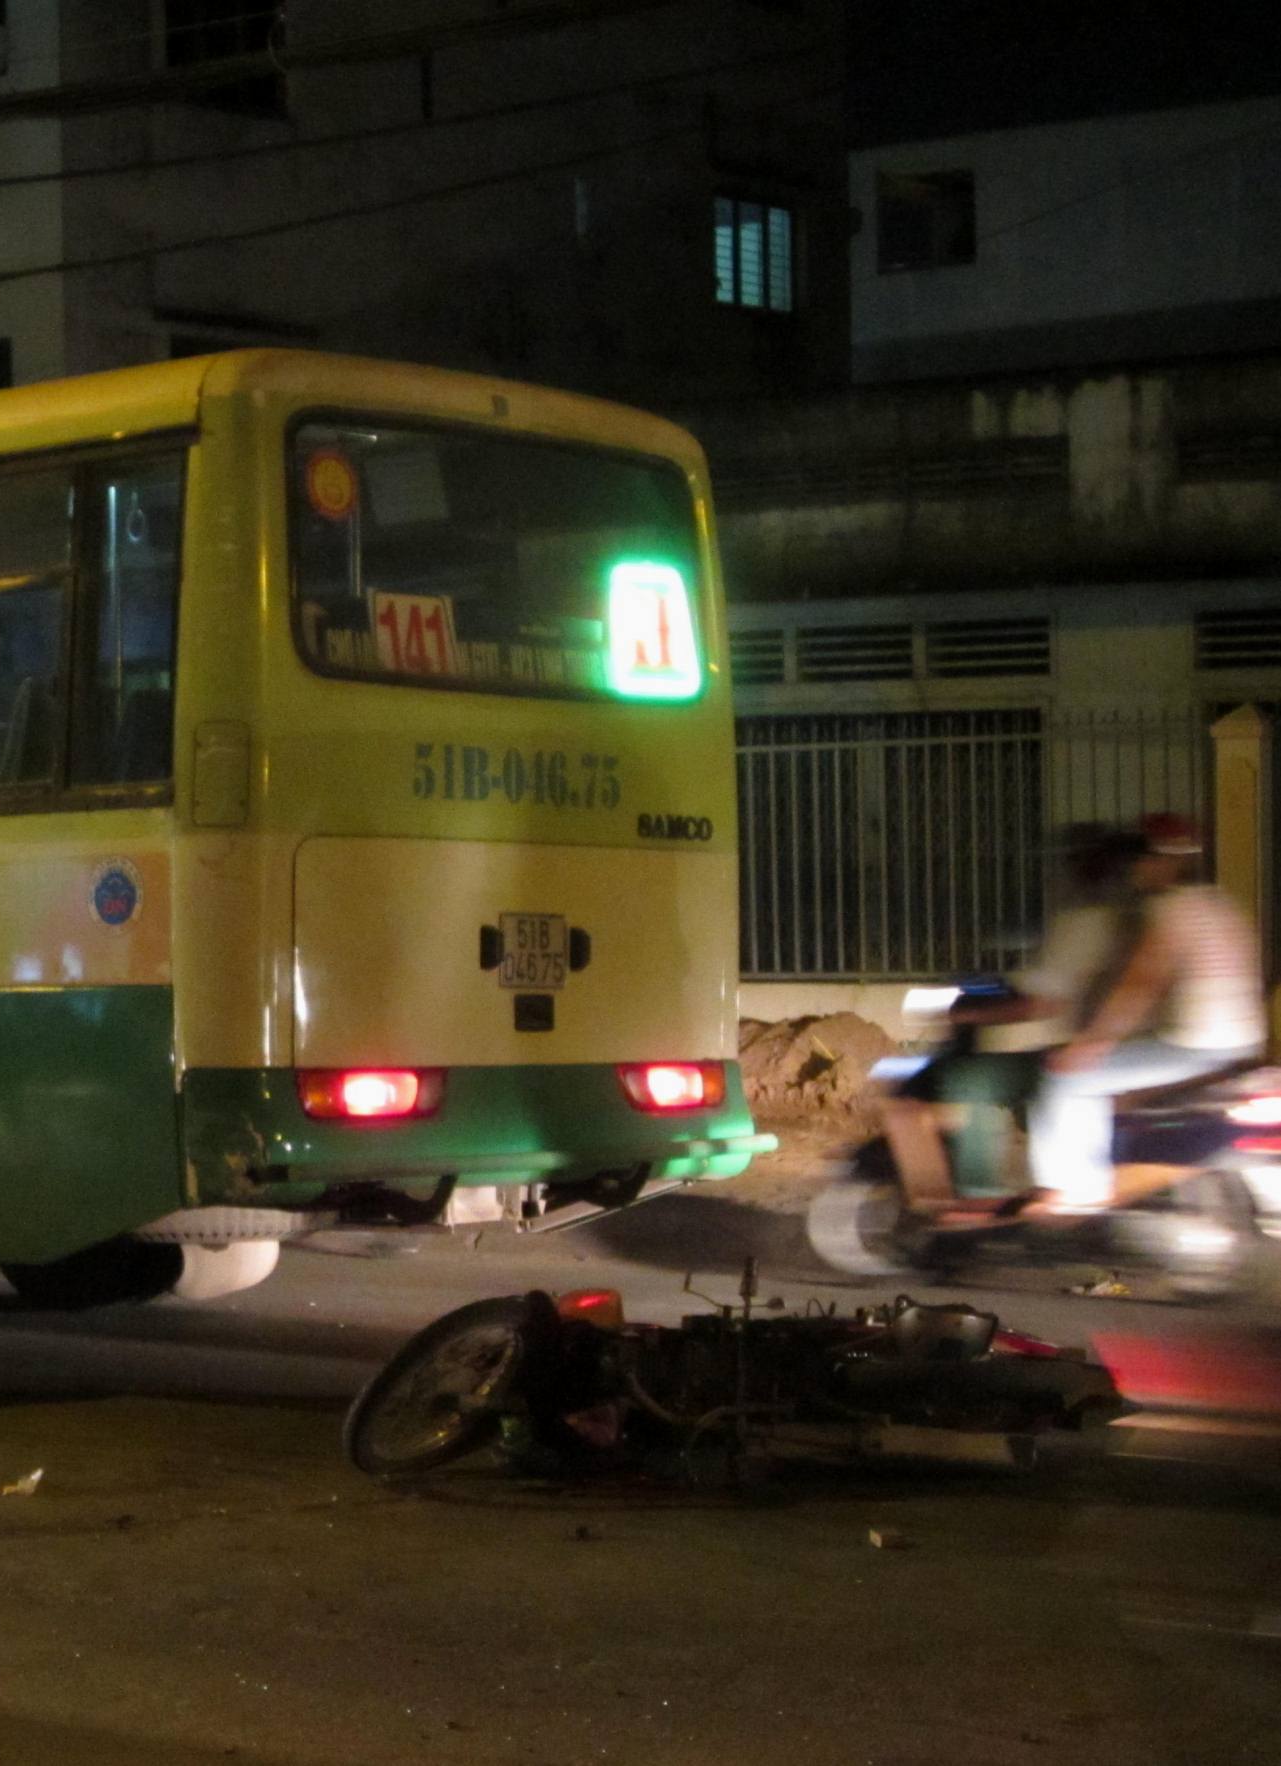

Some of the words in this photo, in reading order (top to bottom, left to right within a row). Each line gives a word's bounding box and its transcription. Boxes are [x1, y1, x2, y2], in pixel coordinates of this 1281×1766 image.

[379, 600, 450, 674] 141
[412, 743, 622, 809] 51B-046.75
[636, 813, 714, 842] SAMCO
[517, 919, 550, 949] 51B
